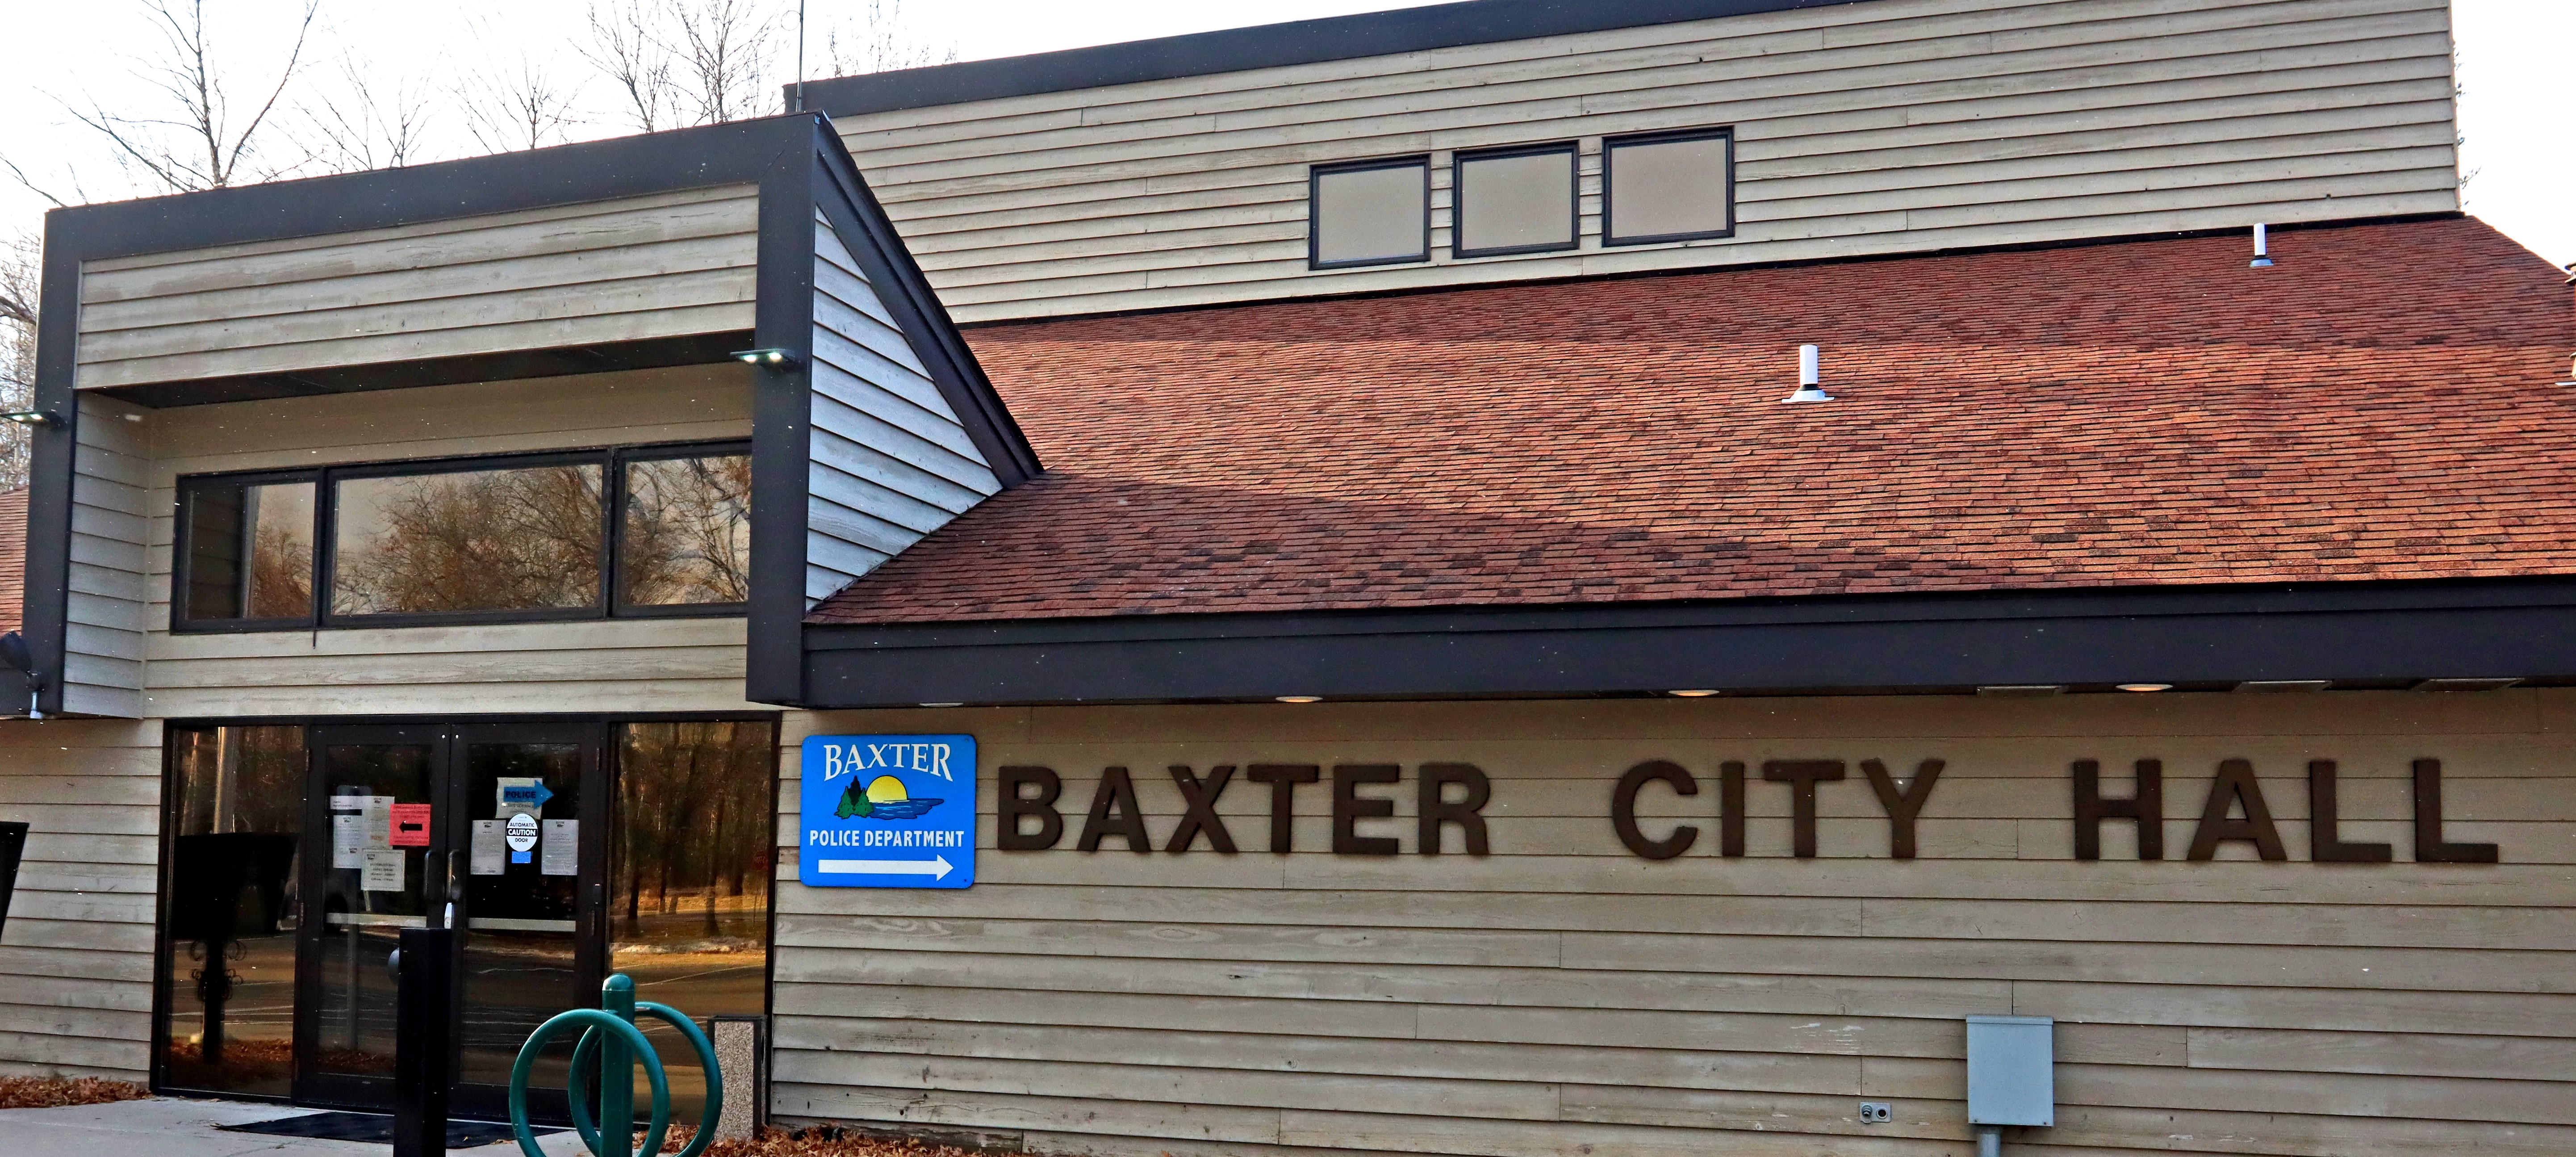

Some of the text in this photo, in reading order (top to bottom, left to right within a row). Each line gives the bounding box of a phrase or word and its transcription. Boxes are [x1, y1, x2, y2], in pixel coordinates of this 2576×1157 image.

[823, 743, 953, 782] BAXTER
[505, 791, 536, 799] POLICE
[997, 759, 2499, 863] BAXTER CITY HALL
[809, 830, 965, 847] POLICE DEPARTMENT
